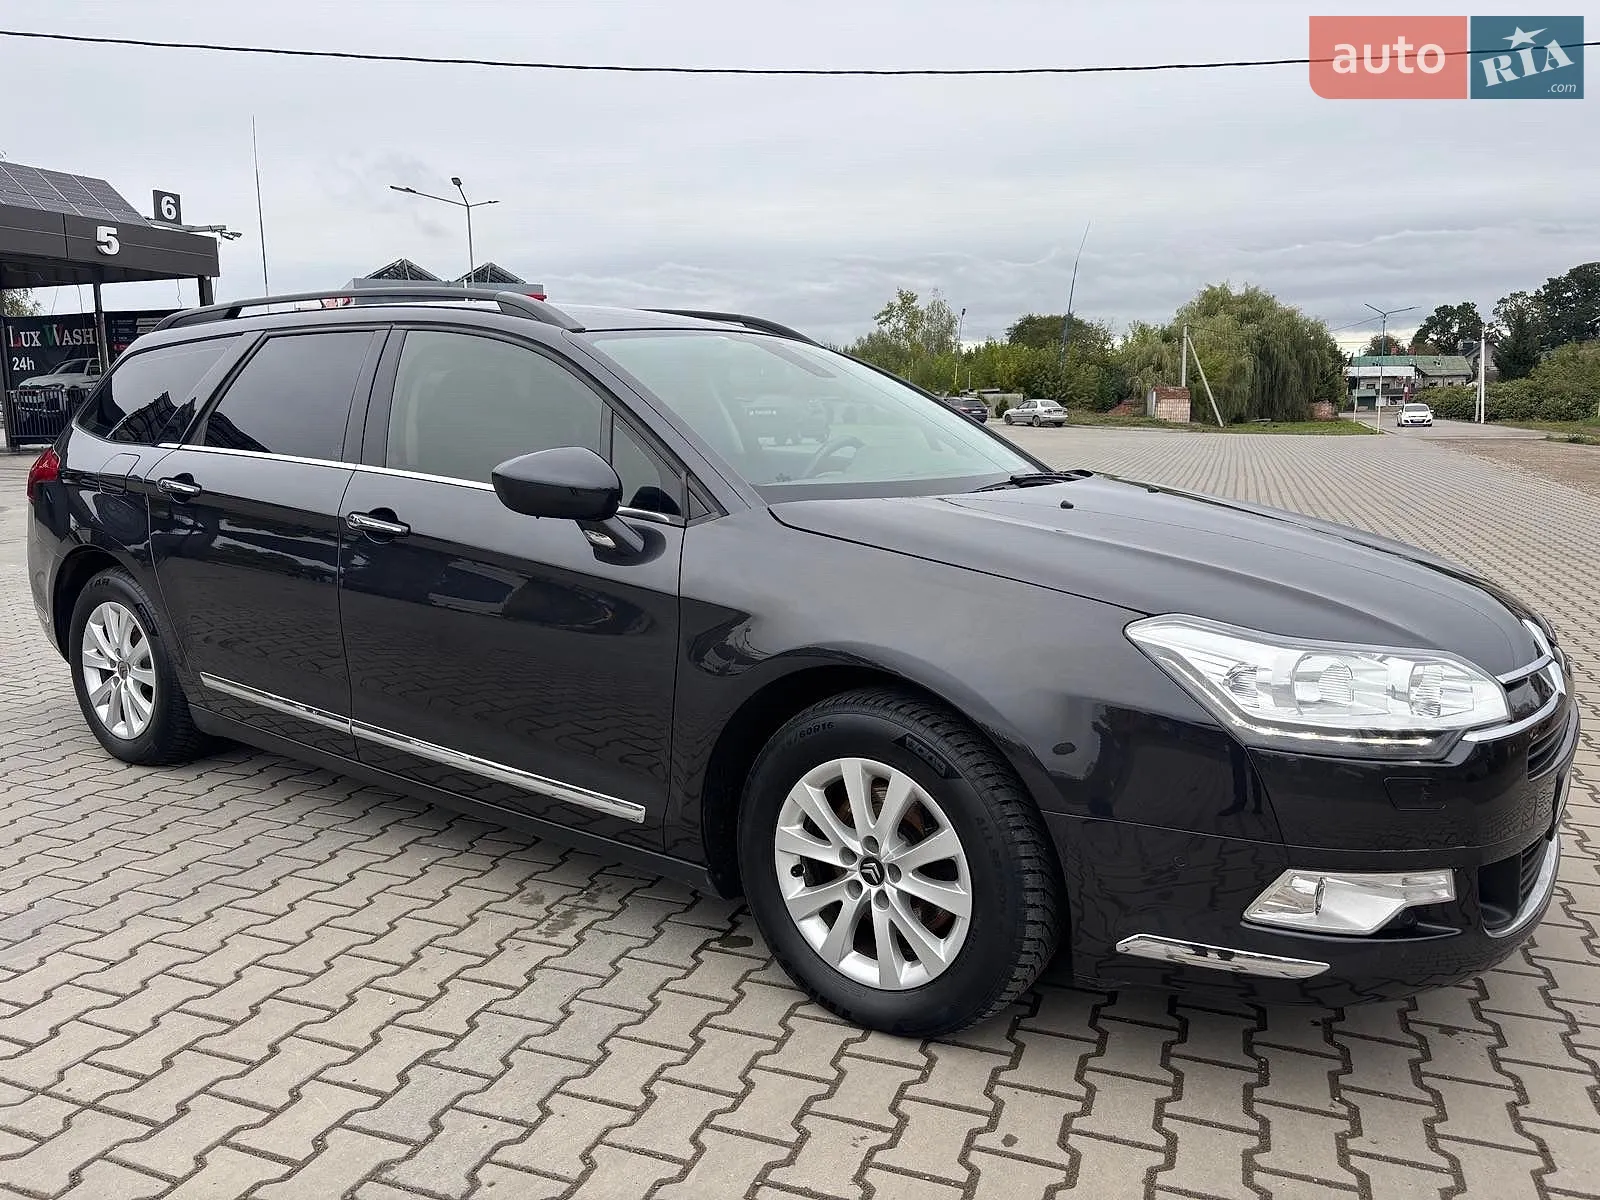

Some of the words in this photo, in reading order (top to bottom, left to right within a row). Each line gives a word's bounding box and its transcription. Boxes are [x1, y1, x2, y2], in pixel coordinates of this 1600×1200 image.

[161, 195, 177, 220] 6
[96, 225, 120, 255] 5
[7, 325, 42, 349] LUX
[42, 323, 96, 347] WASH
[12, 356, 35, 371] 24h
